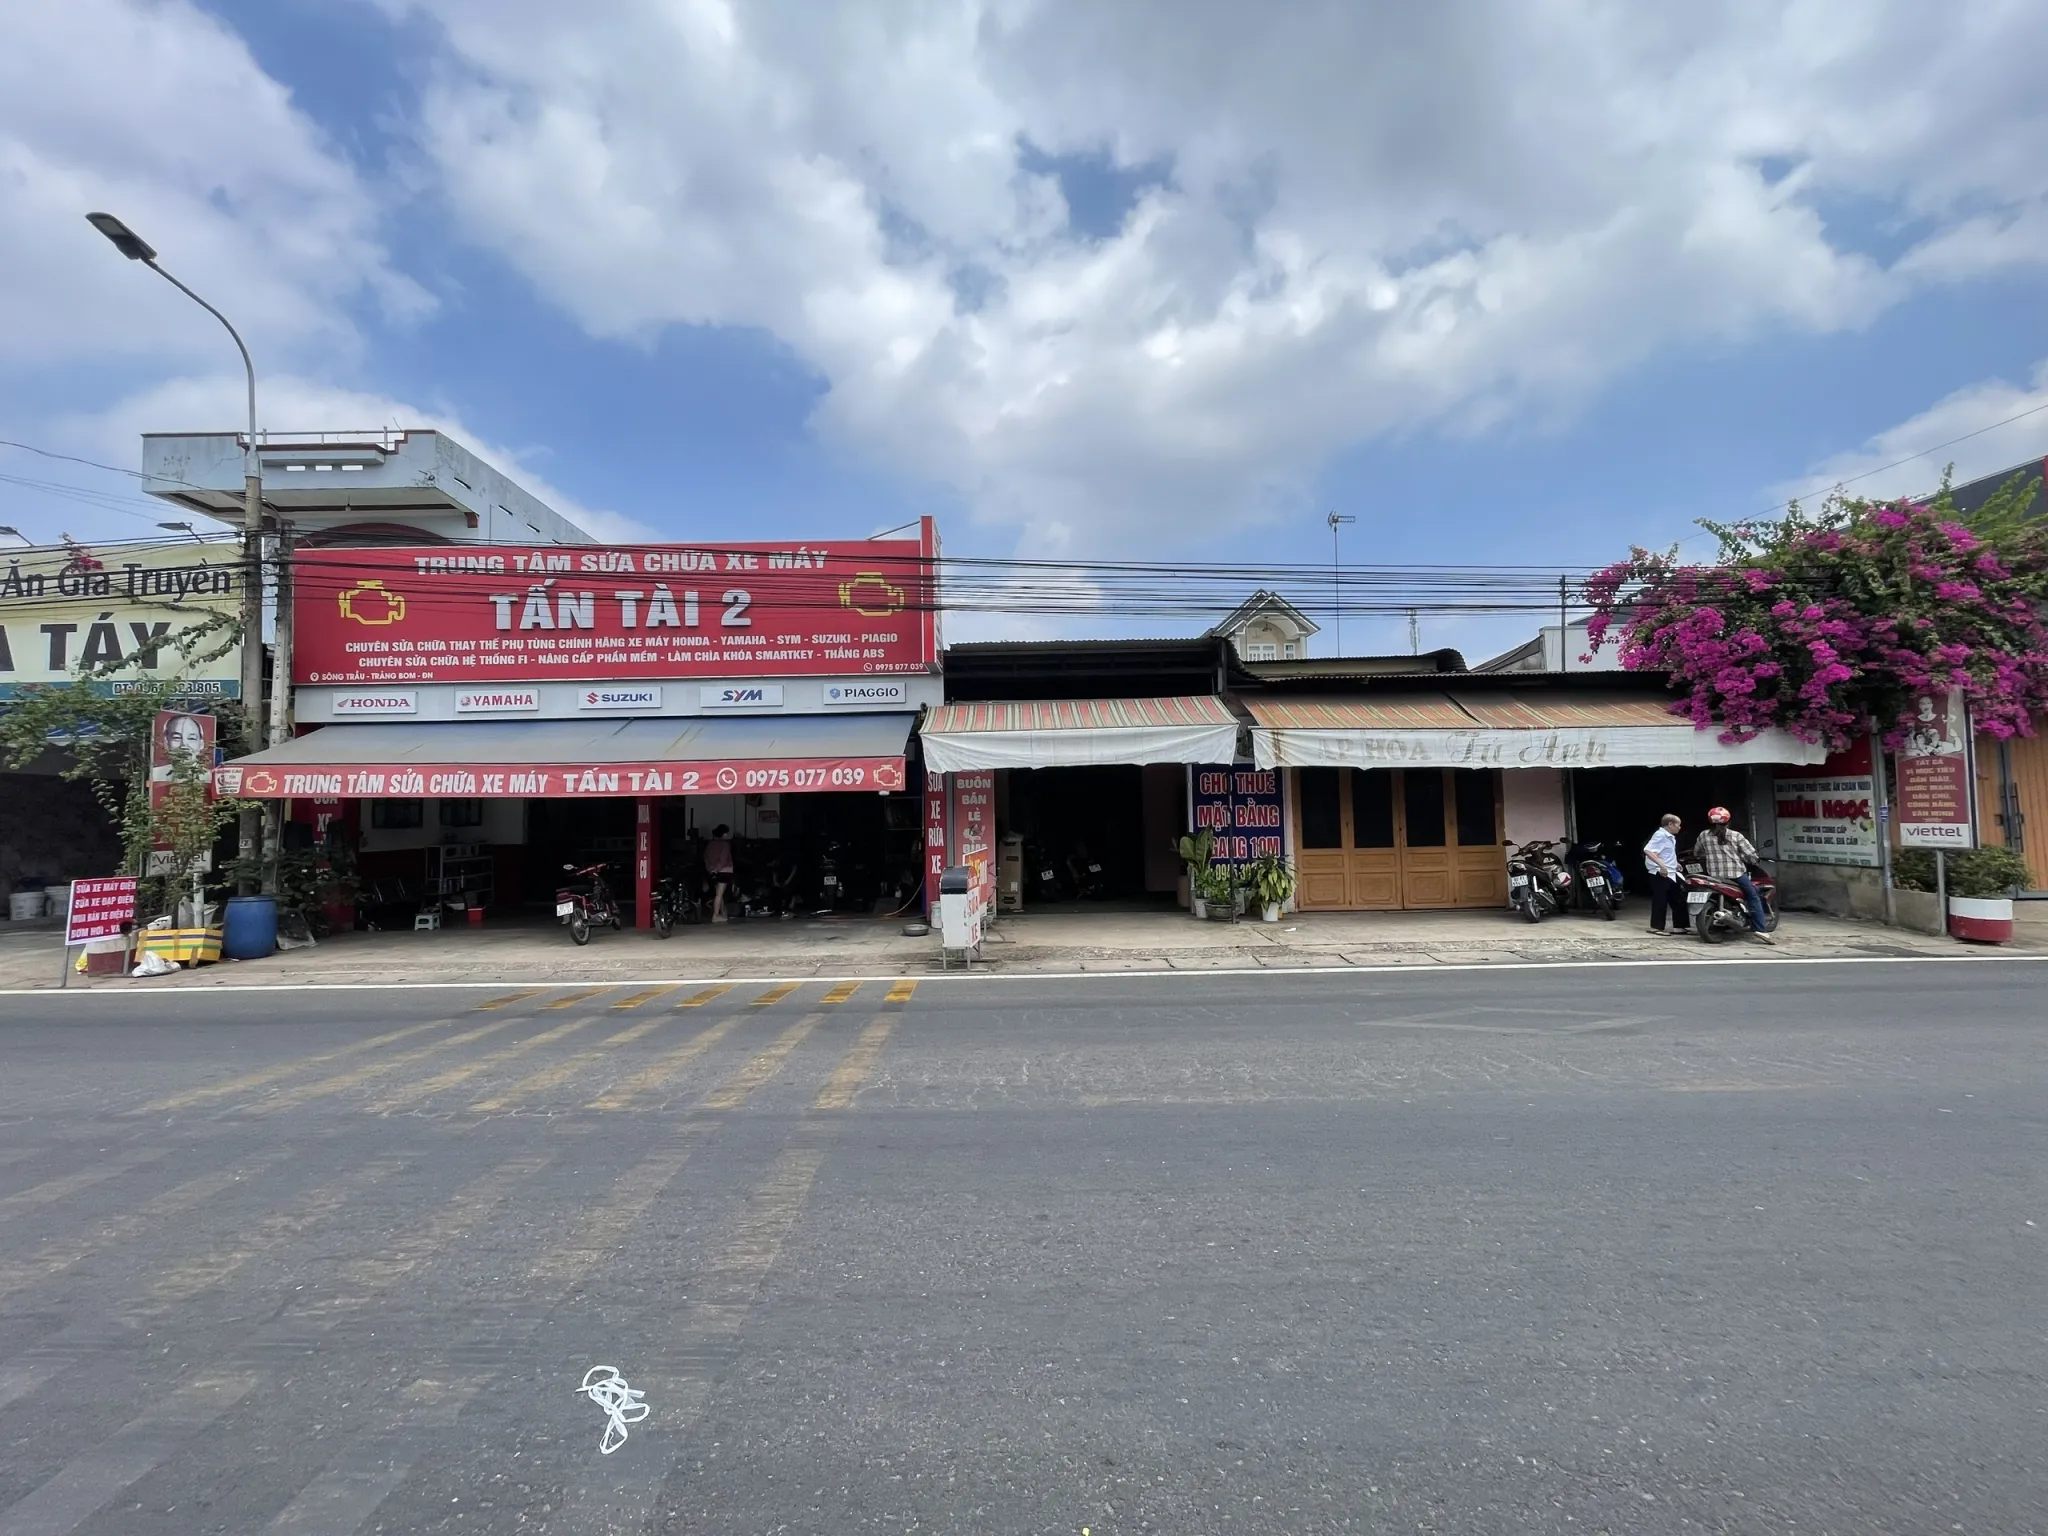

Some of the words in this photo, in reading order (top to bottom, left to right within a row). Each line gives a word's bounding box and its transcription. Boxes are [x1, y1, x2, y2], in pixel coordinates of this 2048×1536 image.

[414, 556, 505, 575] TRUNG
[513, 552, 572, 573] TÂM
[725, 552, 760, 571] XE
[768, 547, 828, 569] MÁY
[123, 559, 230, 602] Truyền
[614, 583, 699, 628] TÀI
[720, 589, 752, 627] 2
[40, 612, 171, 671] TÁY
[345, 641, 389, 653] CHUYÊN
[449, 640, 476, 651] THAY
[479, 637, 500, 650] THẾ
[502, 640, 524, 652] PHỤ
[527, 637, 556, 649] TÙNG
[559, 637, 592, 649] CHÍNH
[628, 638, 642, 647] XE
[645, 635, 670, 647] MÁY
[672, 636, 710, 646] HONDA
[721, 635, 766, 645] YAMAHA
[777, 635, 801, 644] SYM
[811, 634, 851, 643] SUZUKI
[861, 633, 898, 643] PIAGIO
[359, 656, 403, 667] CHUYÊN
[479, 653, 515, 665] THỐNG
[518, 655, 528, 664] FI
[538, 652, 569, 664] NÂNG
[572, 651, 595, 664] CẤP
[667, 651, 692, 662] LÀM
[695, 650, 720, 661] CHÌA
[723, 649, 753, 661] KHÓA
[755, 650, 814, 660] SMARTKEY
[863, 649, 885, 658] ABS
[875, 663, 893, 671] 0975
[321, 671, 344, 680] SÔNG
[602, 693, 653, 702] SUZUKI
[721, 689, 763, 702] SYM
[844, 688, 899, 697] PIAGGIO
[350, 698, 411, 708] HONDA
[473, 695, 534, 706] YAMAHA
[284, 774, 342, 794] TRUNG
[347, 771, 385, 794] TÂM
[389, 768, 424, 793] SỬA
[429, 770, 476, 793] CHỮA
[481, 774, 504, 793] XE
[509, 769, 549, 793] MÁY
[563, 767, 619, 792] TẤN
[627, 768, 673, 791] TÀI
[681, 772, 700, 790] 2
[745, 769, 790, 787] 0975
[794, 769, 827, 786] 077
[831, 768, 865, 785] 039
[957, 776, 991, 788] BUÔN
[1200, 772, 1233, 794] CHO
[1235, 770, 1276, 794] THUÊ
[962, 792, 987, 804] BÁN
[930, 801, 941, 819] XE
[1197, 801, 1232, 831] MẶT
[1236, 797, 1280, 827] BẰNG
[928, 822, 944, 846] RỬA
[1906, 826, 1962, 837] viettel
[1250, 837, 1280, 858] 10M
[932, 855, 941, 874] XE
[92, 883, 102, 892] XE
[103, 881, 119, 891] MÁY
[91, 897, 101, 906] XE
[87, 911, 100, 921] BÁN
[101, 912, 109, 920] XE
